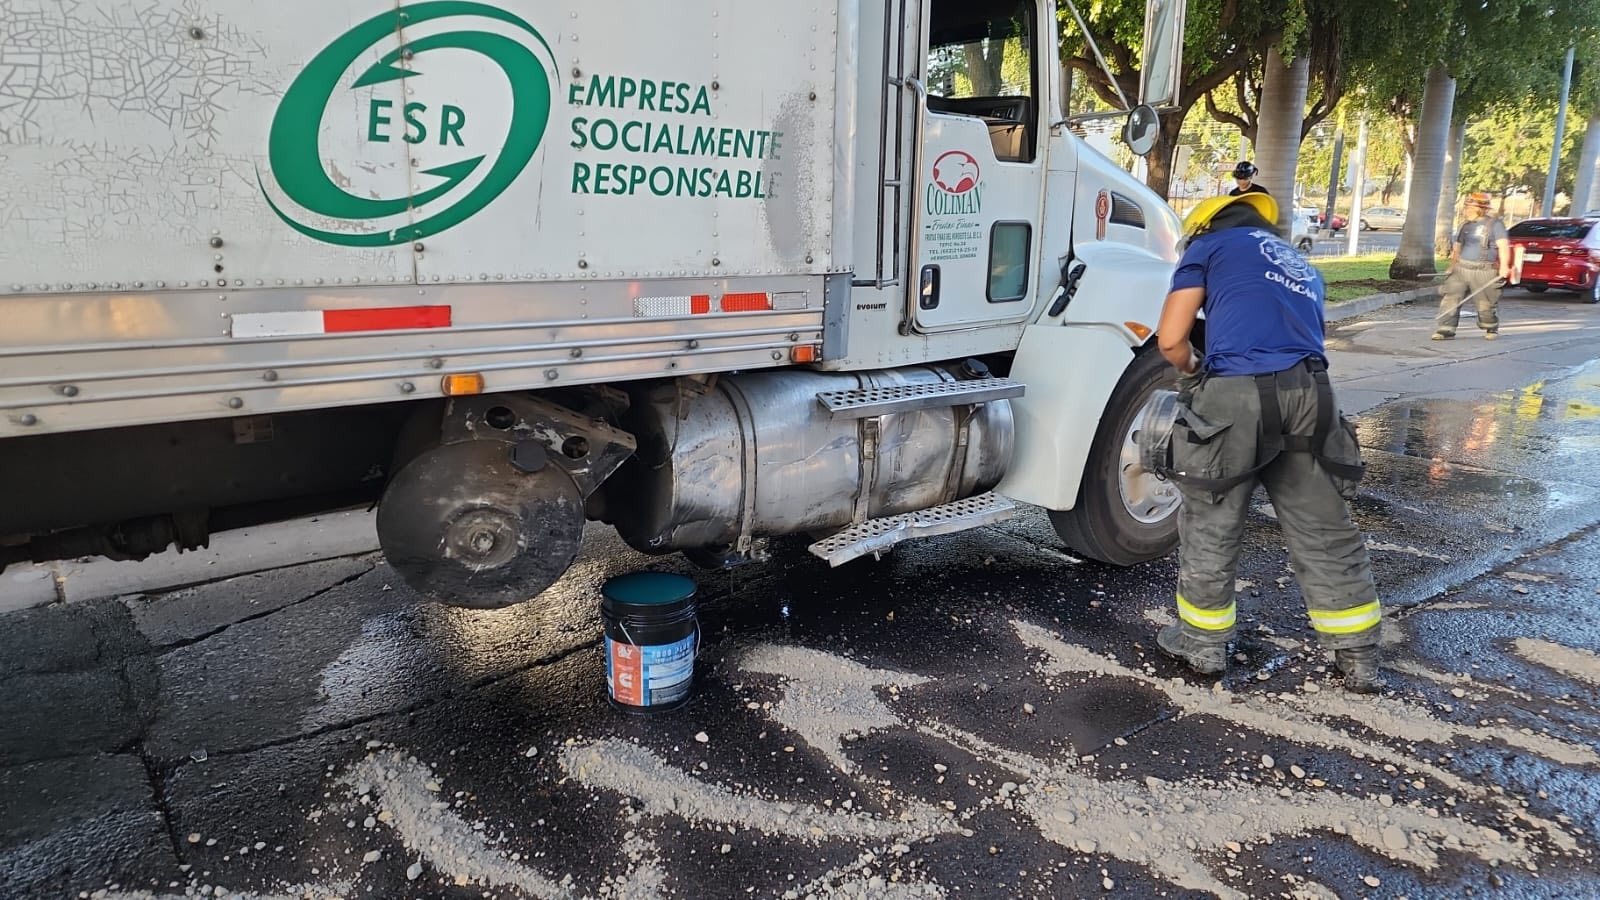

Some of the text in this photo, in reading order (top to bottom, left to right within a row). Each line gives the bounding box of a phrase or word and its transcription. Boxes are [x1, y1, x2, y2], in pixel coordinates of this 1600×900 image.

[568, 74, 711, 115] EMPRESA
[367, 98, 466, 147] ESR
[570, 116, 784, 160] SOCIALMENTE
[926, 181, 983, 215] COLIMAN
